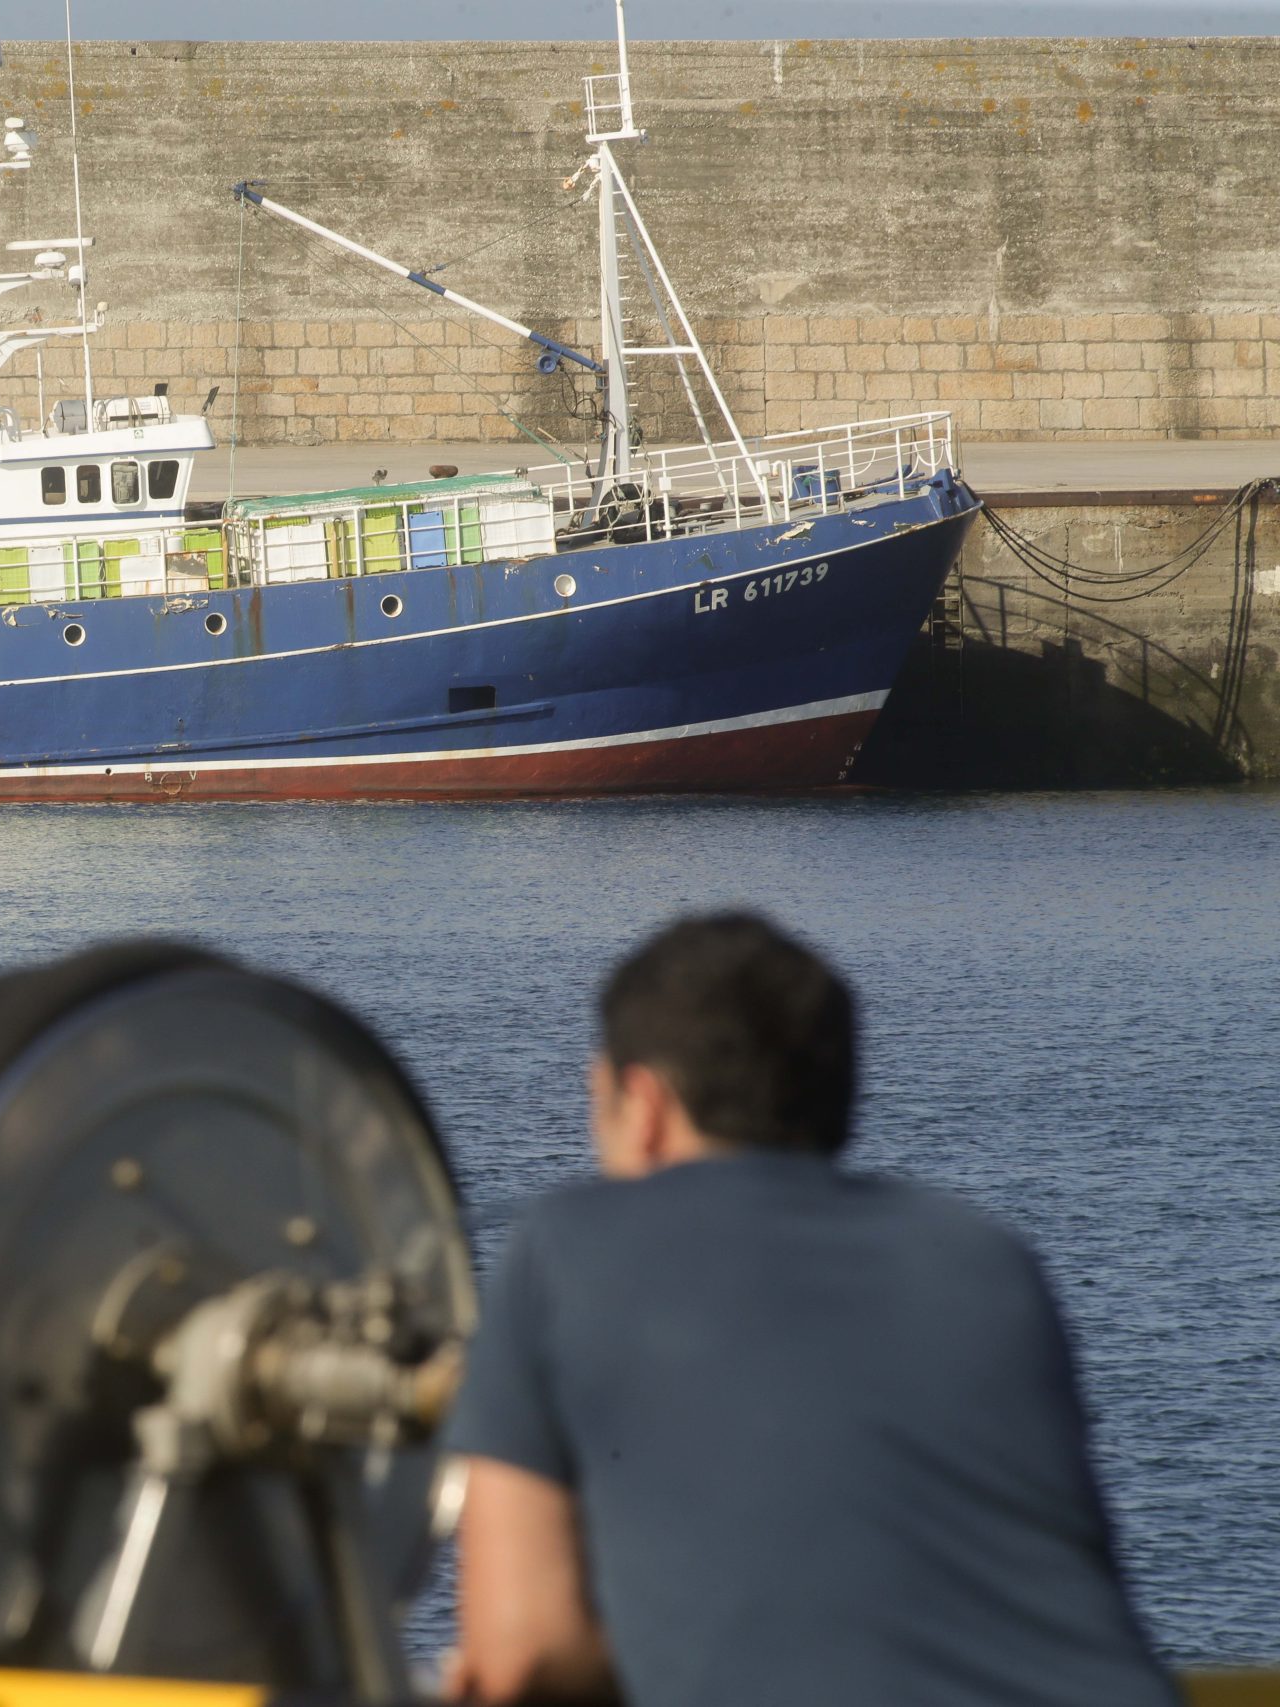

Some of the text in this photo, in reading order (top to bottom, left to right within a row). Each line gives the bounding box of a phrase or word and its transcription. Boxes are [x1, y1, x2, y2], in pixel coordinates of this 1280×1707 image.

[694, 562, 829, 614] LR 611739
[144, 772, 153, 783] B
